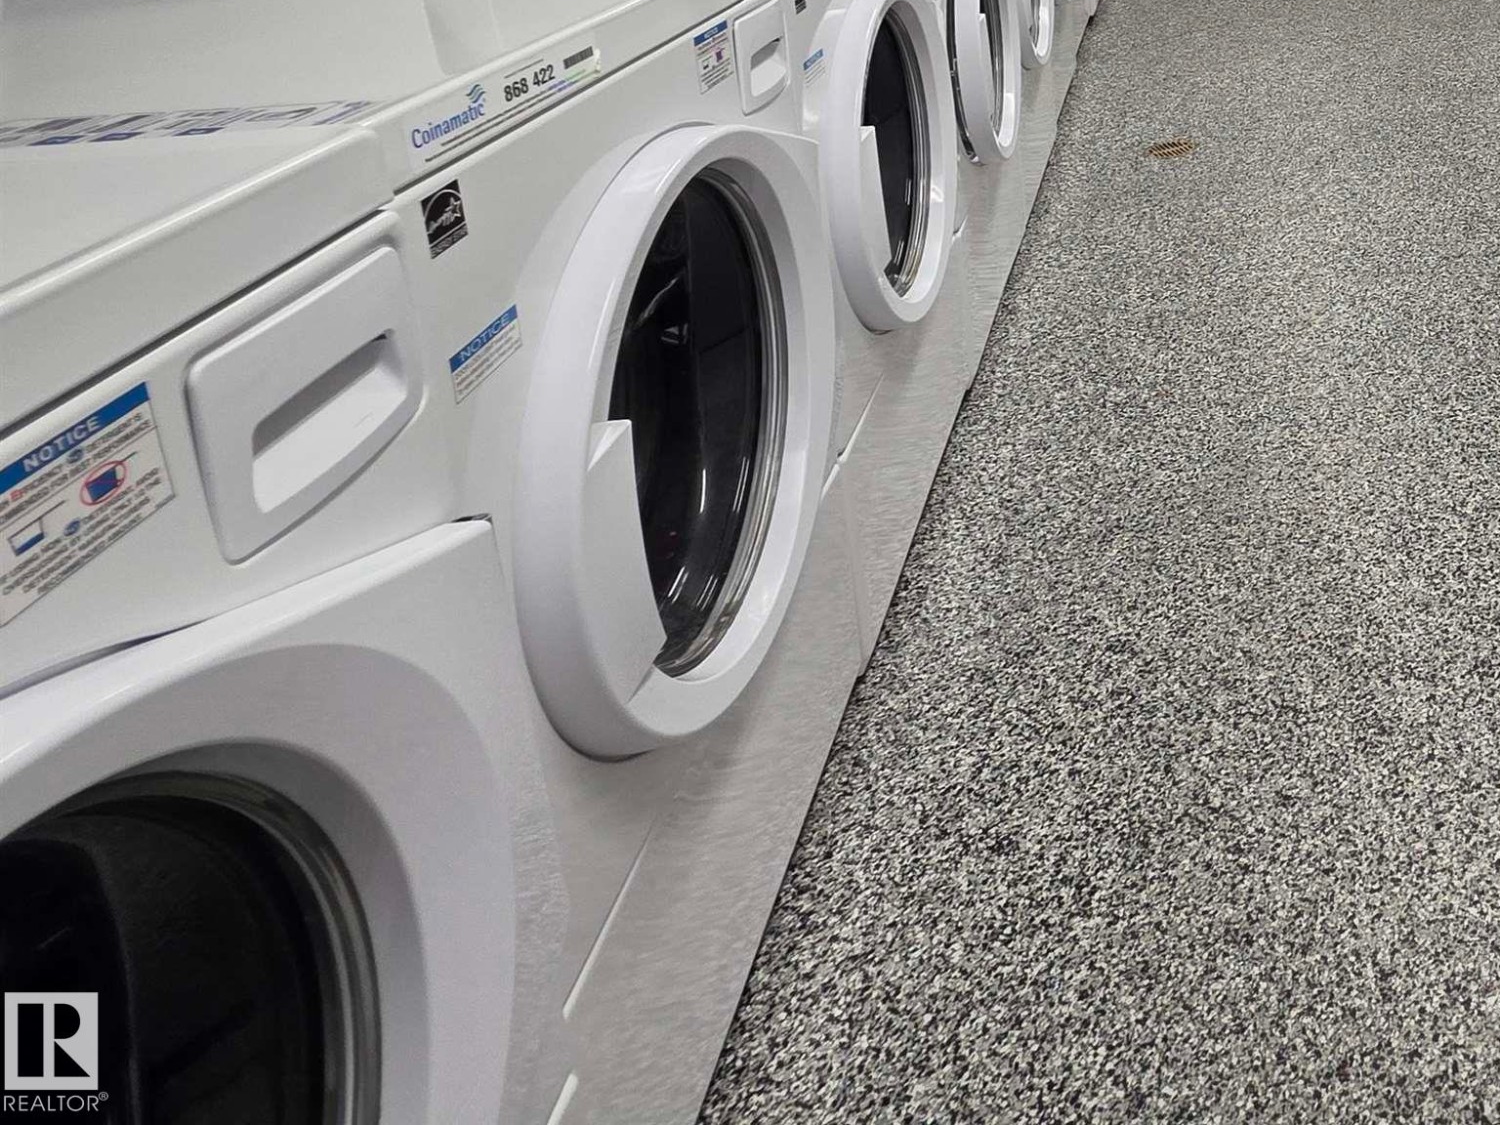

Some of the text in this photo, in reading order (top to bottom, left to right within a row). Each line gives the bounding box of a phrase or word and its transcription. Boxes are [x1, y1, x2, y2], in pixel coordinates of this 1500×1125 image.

[503, 77, 529, 102] 868
[532, 64, 555, 87] 422
[411, 103, 486, 148] Coinamatic
[460, 313, 508, 361] NOTICE
[23, 416, 100, 472] NOTICE
